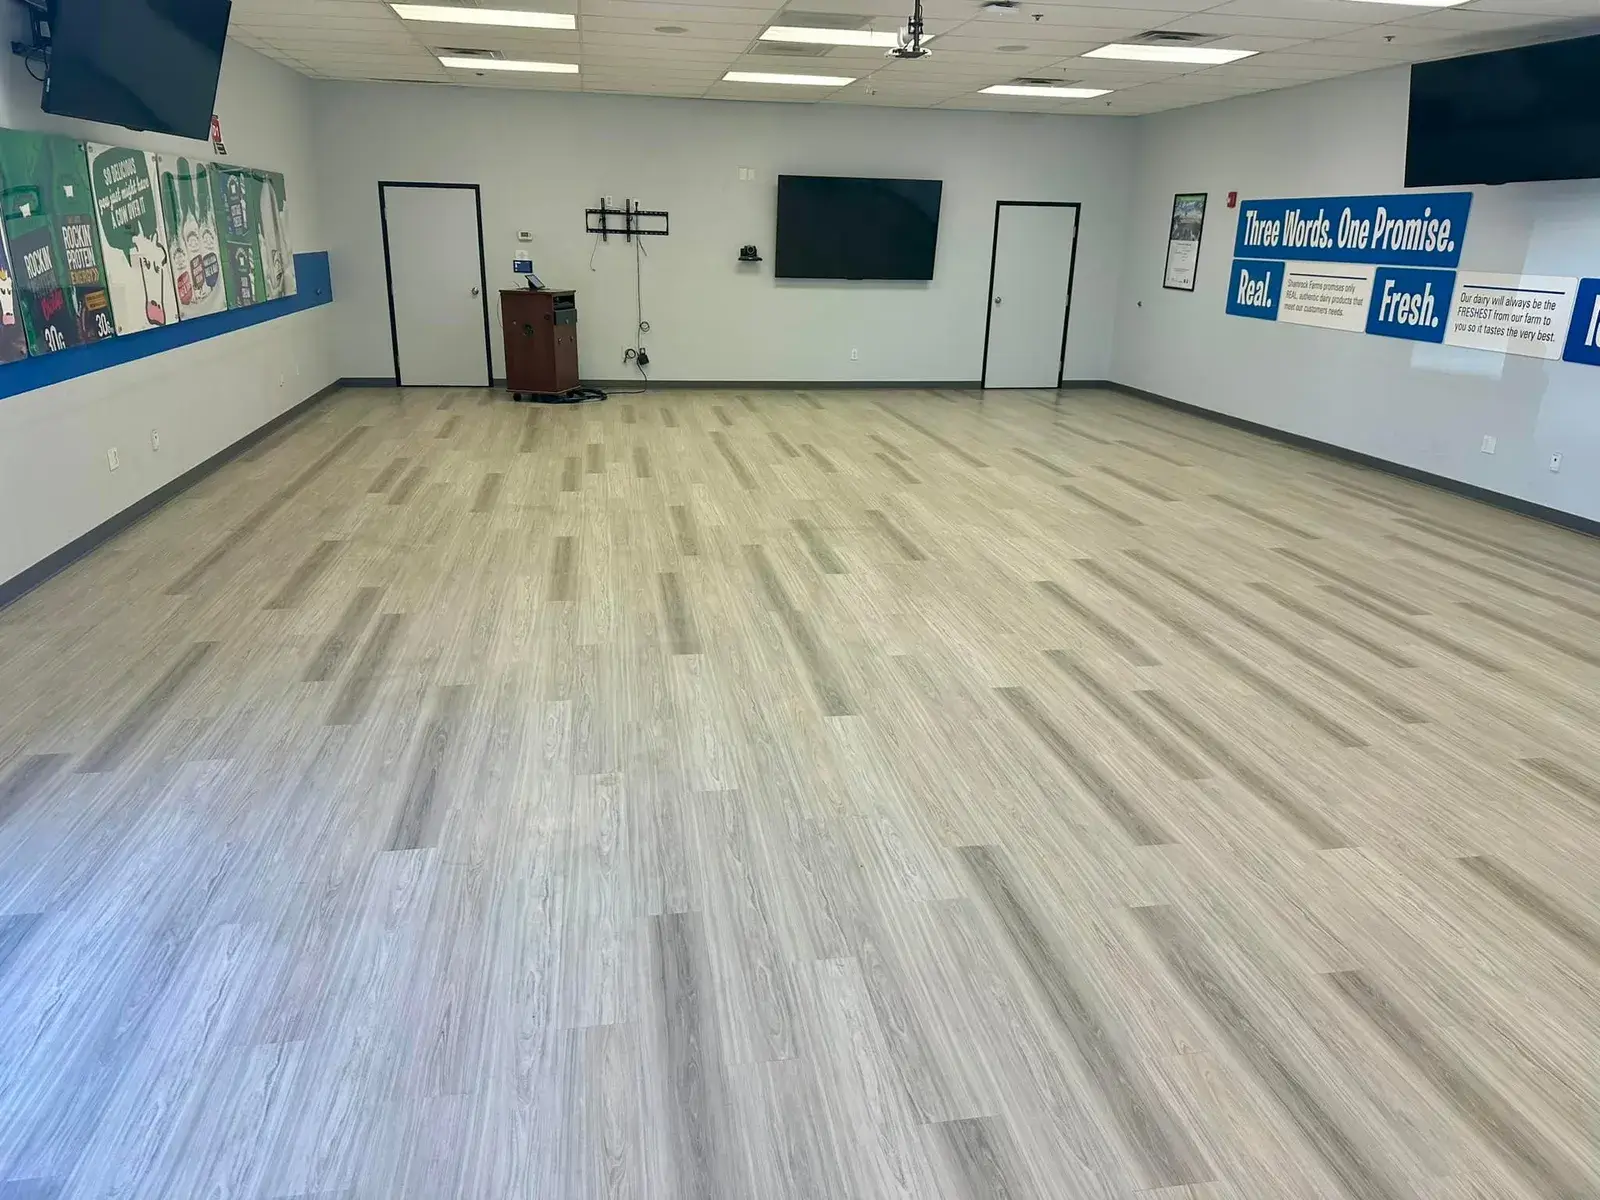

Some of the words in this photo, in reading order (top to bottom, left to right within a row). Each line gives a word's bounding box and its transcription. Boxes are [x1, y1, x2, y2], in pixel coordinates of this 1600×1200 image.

[1244, 210, 1281, 247] Three
[1282, 206, 1334, 248] Words.
[1337, 206, 1371, 249] One
[1370, 206, 1456, 253] Promise.
[1236, 268, 1272, 308] Real.
[1344, 283, 1356, 295] only
[1295, 304, 1304, 312] our
[1319, 294, 1332, 304] dairy
[1330, 296, 1353, 306] products
[1352, 297, 1364, 306] that
[1378, 279, 1439, 328] Fresh.
[1460, 292, 1473, 304] Our
[1472, 294, 1491, 307] dairy
[1491, 296, 1505, 306] will
[1505, 296, 1532, 310] always
[1531, 298, 1543, 310] be
[1543, 299, 1557, 311] the
[1457, 306, 1493, 320] FRESHEST
[1492, 309, 1510, 321] from
[1510, 314, 1524, 323] our
[1523, 312, 1542, 325] farm
[1542, 315, 1553, 326] to
[1454, 322, 1467, 333] you
[1467, 323, 1477, 333] so
[1476, 324, 1484, 334] it
[1483, 324, 1506, 337] tastes
[1505, 326, 1519, 338] the
[1518, 330, 1537, 342] very
[1536, 330, 1556, 343] best.
